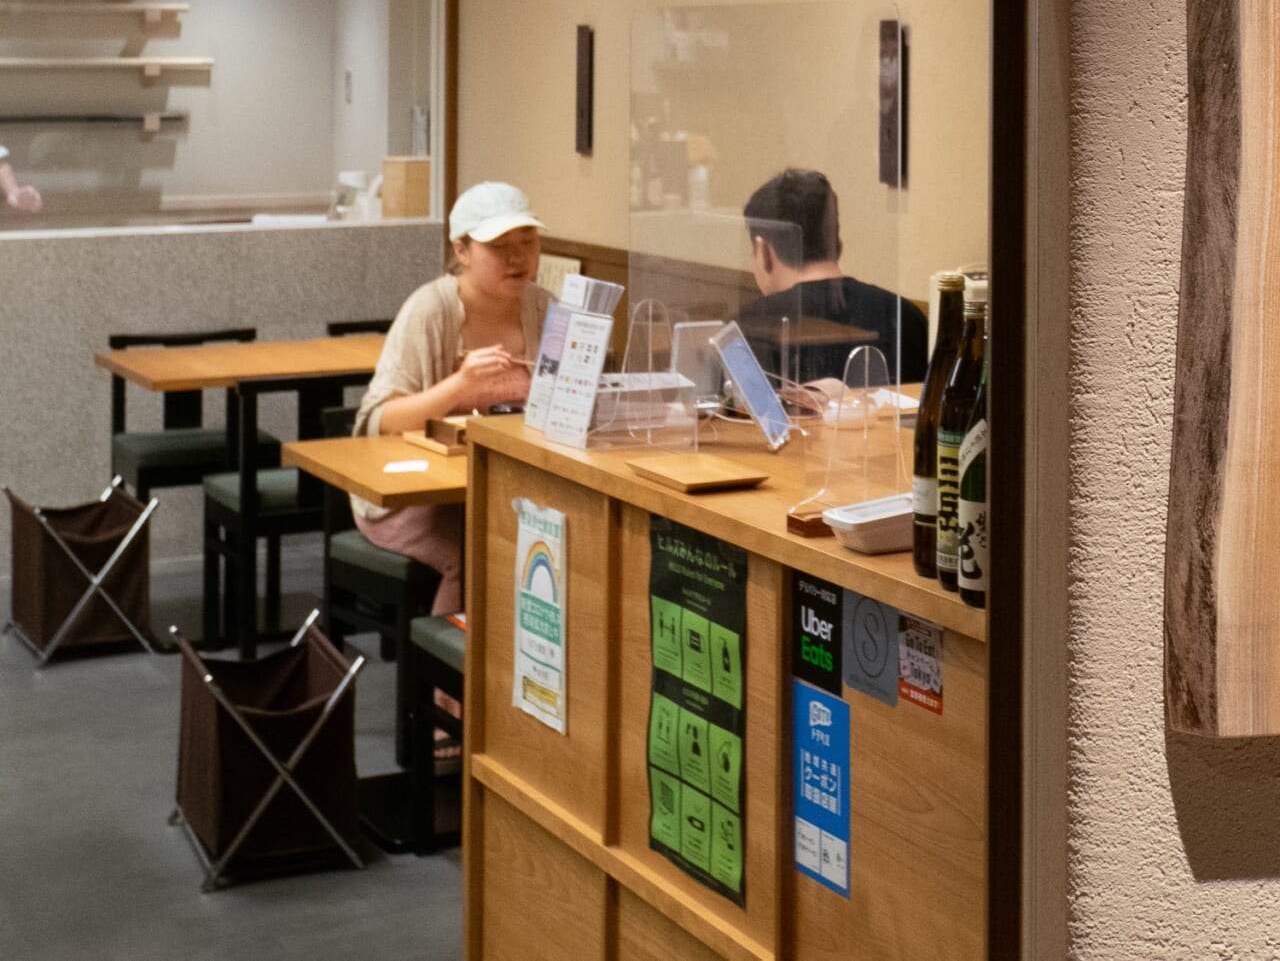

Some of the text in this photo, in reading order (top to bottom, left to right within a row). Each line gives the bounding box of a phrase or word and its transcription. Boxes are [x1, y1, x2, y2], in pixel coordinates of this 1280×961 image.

[801, 605, 834, 641] Uber
[801, 634, 833, 672] Eats
[804, 766, 837, 792] クーポン
